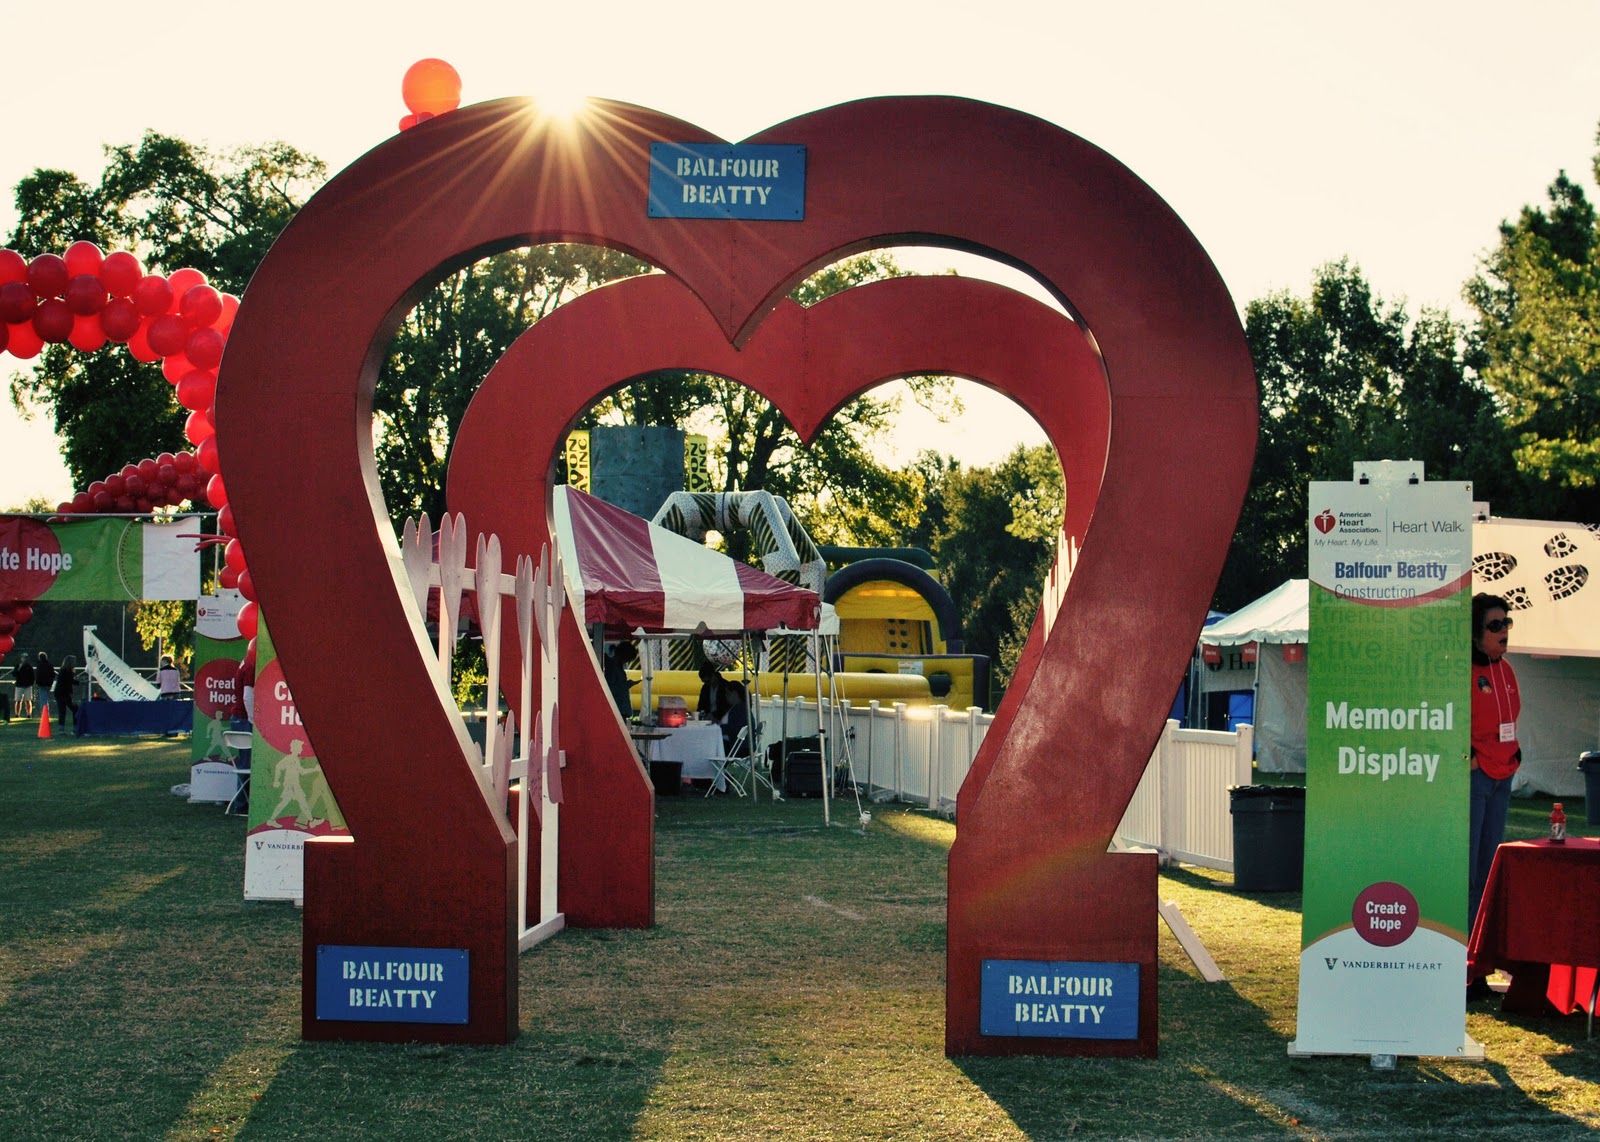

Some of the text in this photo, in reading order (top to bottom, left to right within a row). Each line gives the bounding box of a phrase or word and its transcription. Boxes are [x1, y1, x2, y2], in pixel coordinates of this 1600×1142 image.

[676, 157, 779, 178] BALFOUR
[682, 184, 772, 205] BEATTY
[578, 438, 588, 469] INC
[699, 442, 707, 473] INC
[1339, 519, 1364, 527] Heart
[1392, 521, 1428, 533] Heart
[1314, 539, 1325, 547] My
[1350, 539, 1362, 547] My
[0, 546, 73, 576] te Hope
[1335, 561, 1447, 581] Balfour Beatty
[1334, 584, 1416, 599] Construction
[205, 677, 236, 690] Creat
[209, 691, 237, 705] Hope
[1325, 701, 1453, 730] Memorial
[1338, 745, 1440, 782] Display
[1365, 901, 1407, 915] Create
[1370, 916, 1402, 932] Hope
[342, 961, 444, 982] BALFOUR
[1342, 961, 1405, 970] VANDERBILT
[1408, 962, 1442, 970] HEART
[1008, 975, 1113, 997] BALFOUR
[349, 988, 437, 1009] BEATTY
[1015, 1003, 1106, 1024] BEATTY
